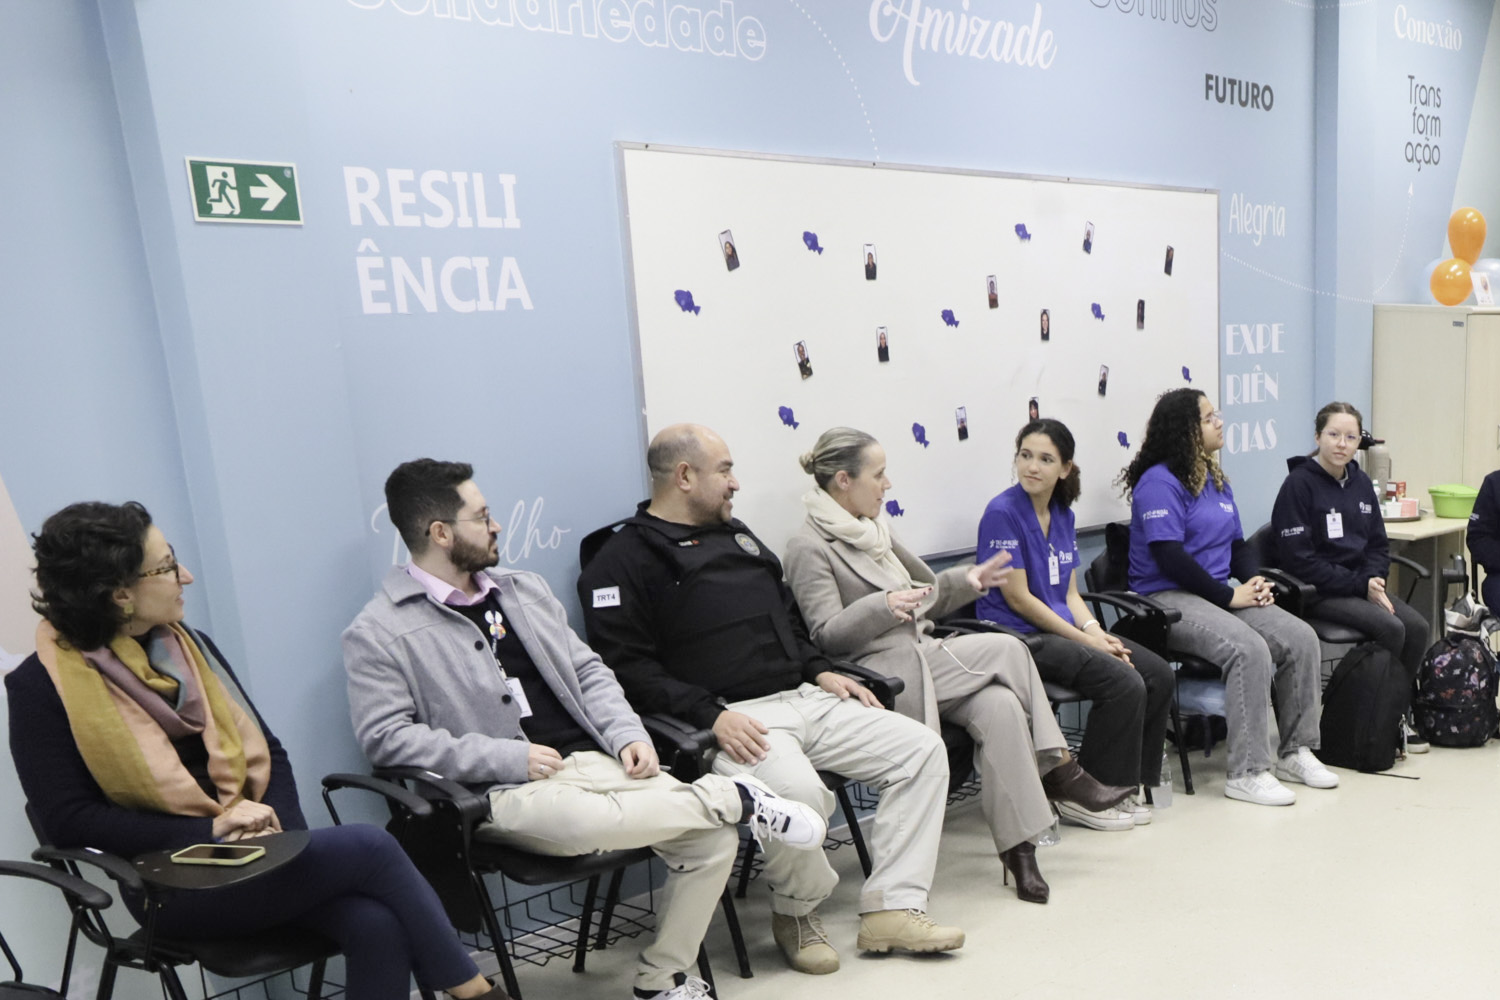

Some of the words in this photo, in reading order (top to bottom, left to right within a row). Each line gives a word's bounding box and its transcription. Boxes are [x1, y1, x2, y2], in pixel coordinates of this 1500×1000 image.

[869, 0, 1057, 86] Amizade
[1395, 4, 1463, 52] Conexão
[1205, 73, 1274, 111] FUTURO
[1408, 75, 1442, 109] Trans
[1412, 106, 1442, 138] form
[1405, 137, 1441, 171] ação
[343, 166, 521, 229] RESILI
[1229, 193, 1286, 246] Alegria
[356, 238, 534, 315] ÊNCIA
[1226, 323, 1285, 355] EXPE
[1226, 364, 1279, 405] RIÊN
[1226, 419, 1277, 455] CIAS
